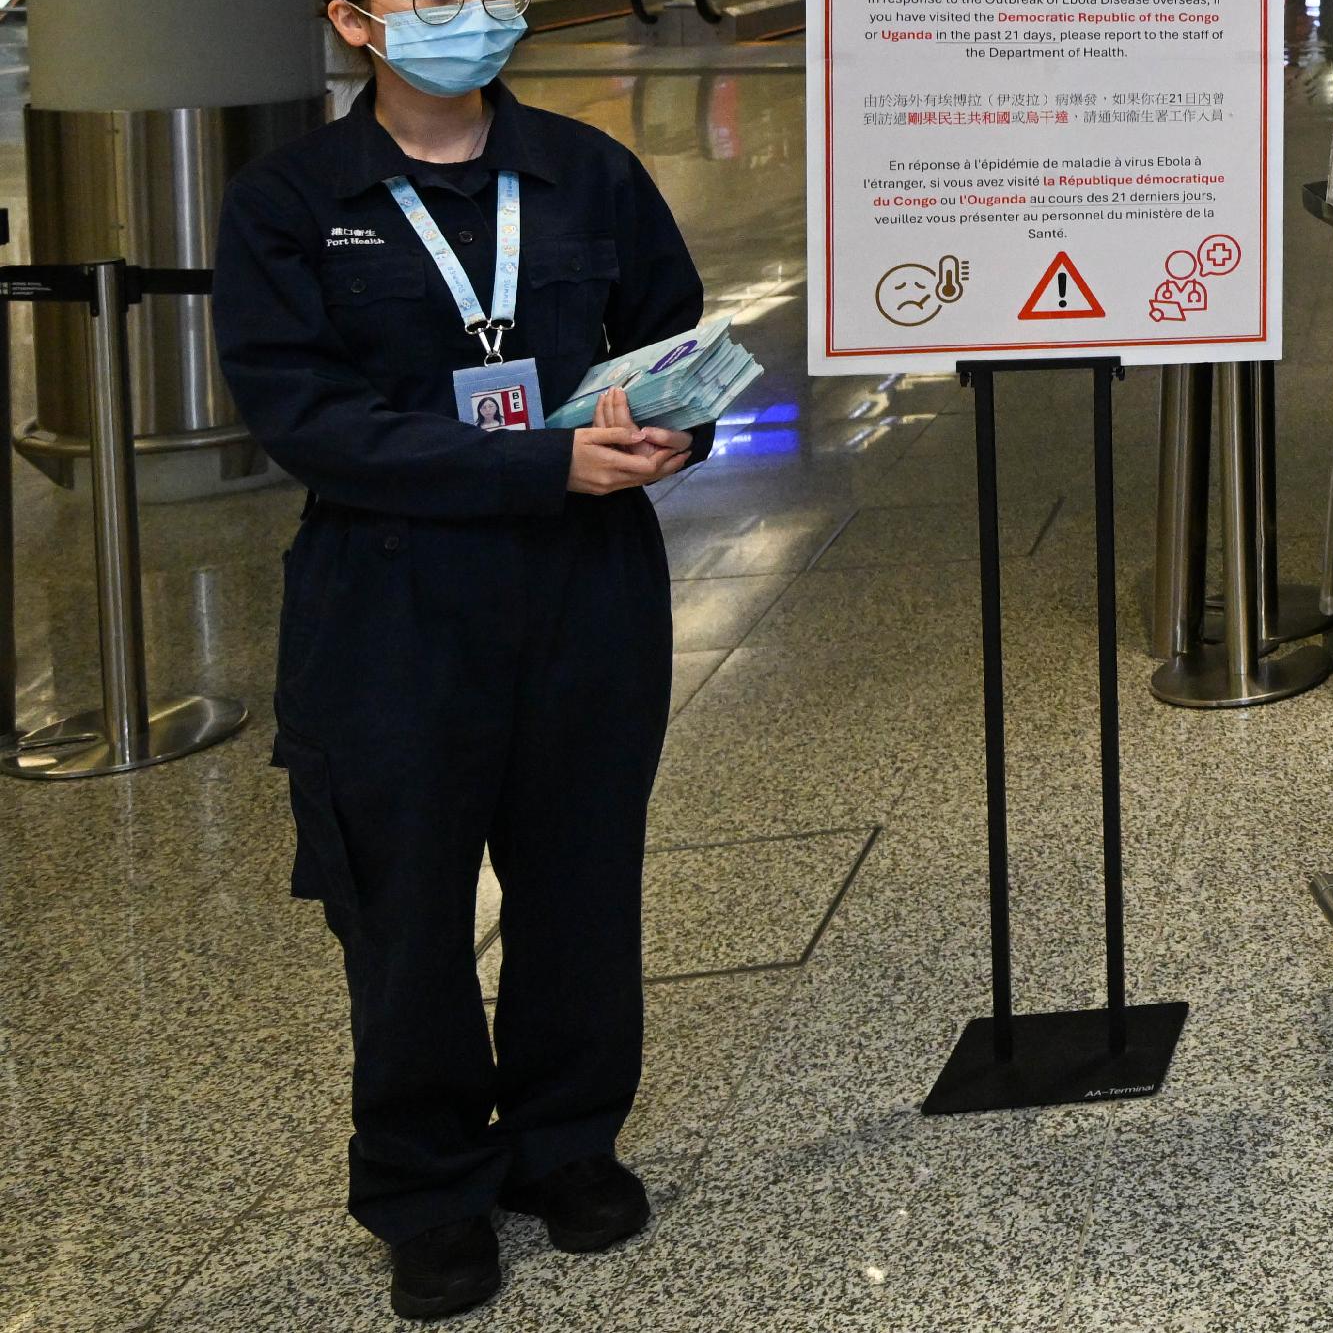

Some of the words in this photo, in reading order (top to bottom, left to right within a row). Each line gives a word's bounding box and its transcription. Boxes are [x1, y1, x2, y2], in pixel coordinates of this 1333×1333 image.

[870, 14, 891, 25] you
[896, 12, 925, 23] have
[929, 12, 970, 23] visited
[974, 12, 994, 23] the
[999, 13, 1074, 23] Democratic
[1079, 13, 1135, 25] Republic
[1139, 13, 1151, 23] of
[1155, 13, 1174, 23] the
[1179, 13, 1219, 25] Congo
[865, 32, 878, 41] or
[881, 30, 932, 42] Uganda
[936, 30, 947, 41] in
[951, 30, 971, 41] the
[974, 30, 1001, 42] past
[1005, 30, 1018, 41] 21
[1023, 30, 1056, 42] days,
[1060, 30, 1100, 42] please
[1104, 31, 1141, 42] report
[1144, 30, 1156, 40] to
[1160, 30, 1179, 40] the
[1182, 29, 1209, 40] staff
[1212, 29, 1223, 40] of
[966, 47, 985, 58] the
[990, 48, 1064, 61] Department
[1068, 48, 1080, 58] of
[1084, 47, 1127, 58] Health.
[864, 178, 925, 192] l'étranger,
[930, 177, 939, 188] si
[944, 178, 973, 188] vous
[977, 178, 1004, 188] avez
[1007, 175, 1039, 186] visité
[1044, 175, 1055, 187] la
[1059, 174, 1132, 189] République
[1136, 173, 1224, 186] démocratique
[326, 238, 349, 247] Port
[350, 237, 385, 245] Health
[512, 391, 520, 400] B
[513, 402, 521, 410] E
[1084, 1084, 1155, 1098] AA-Terminal
